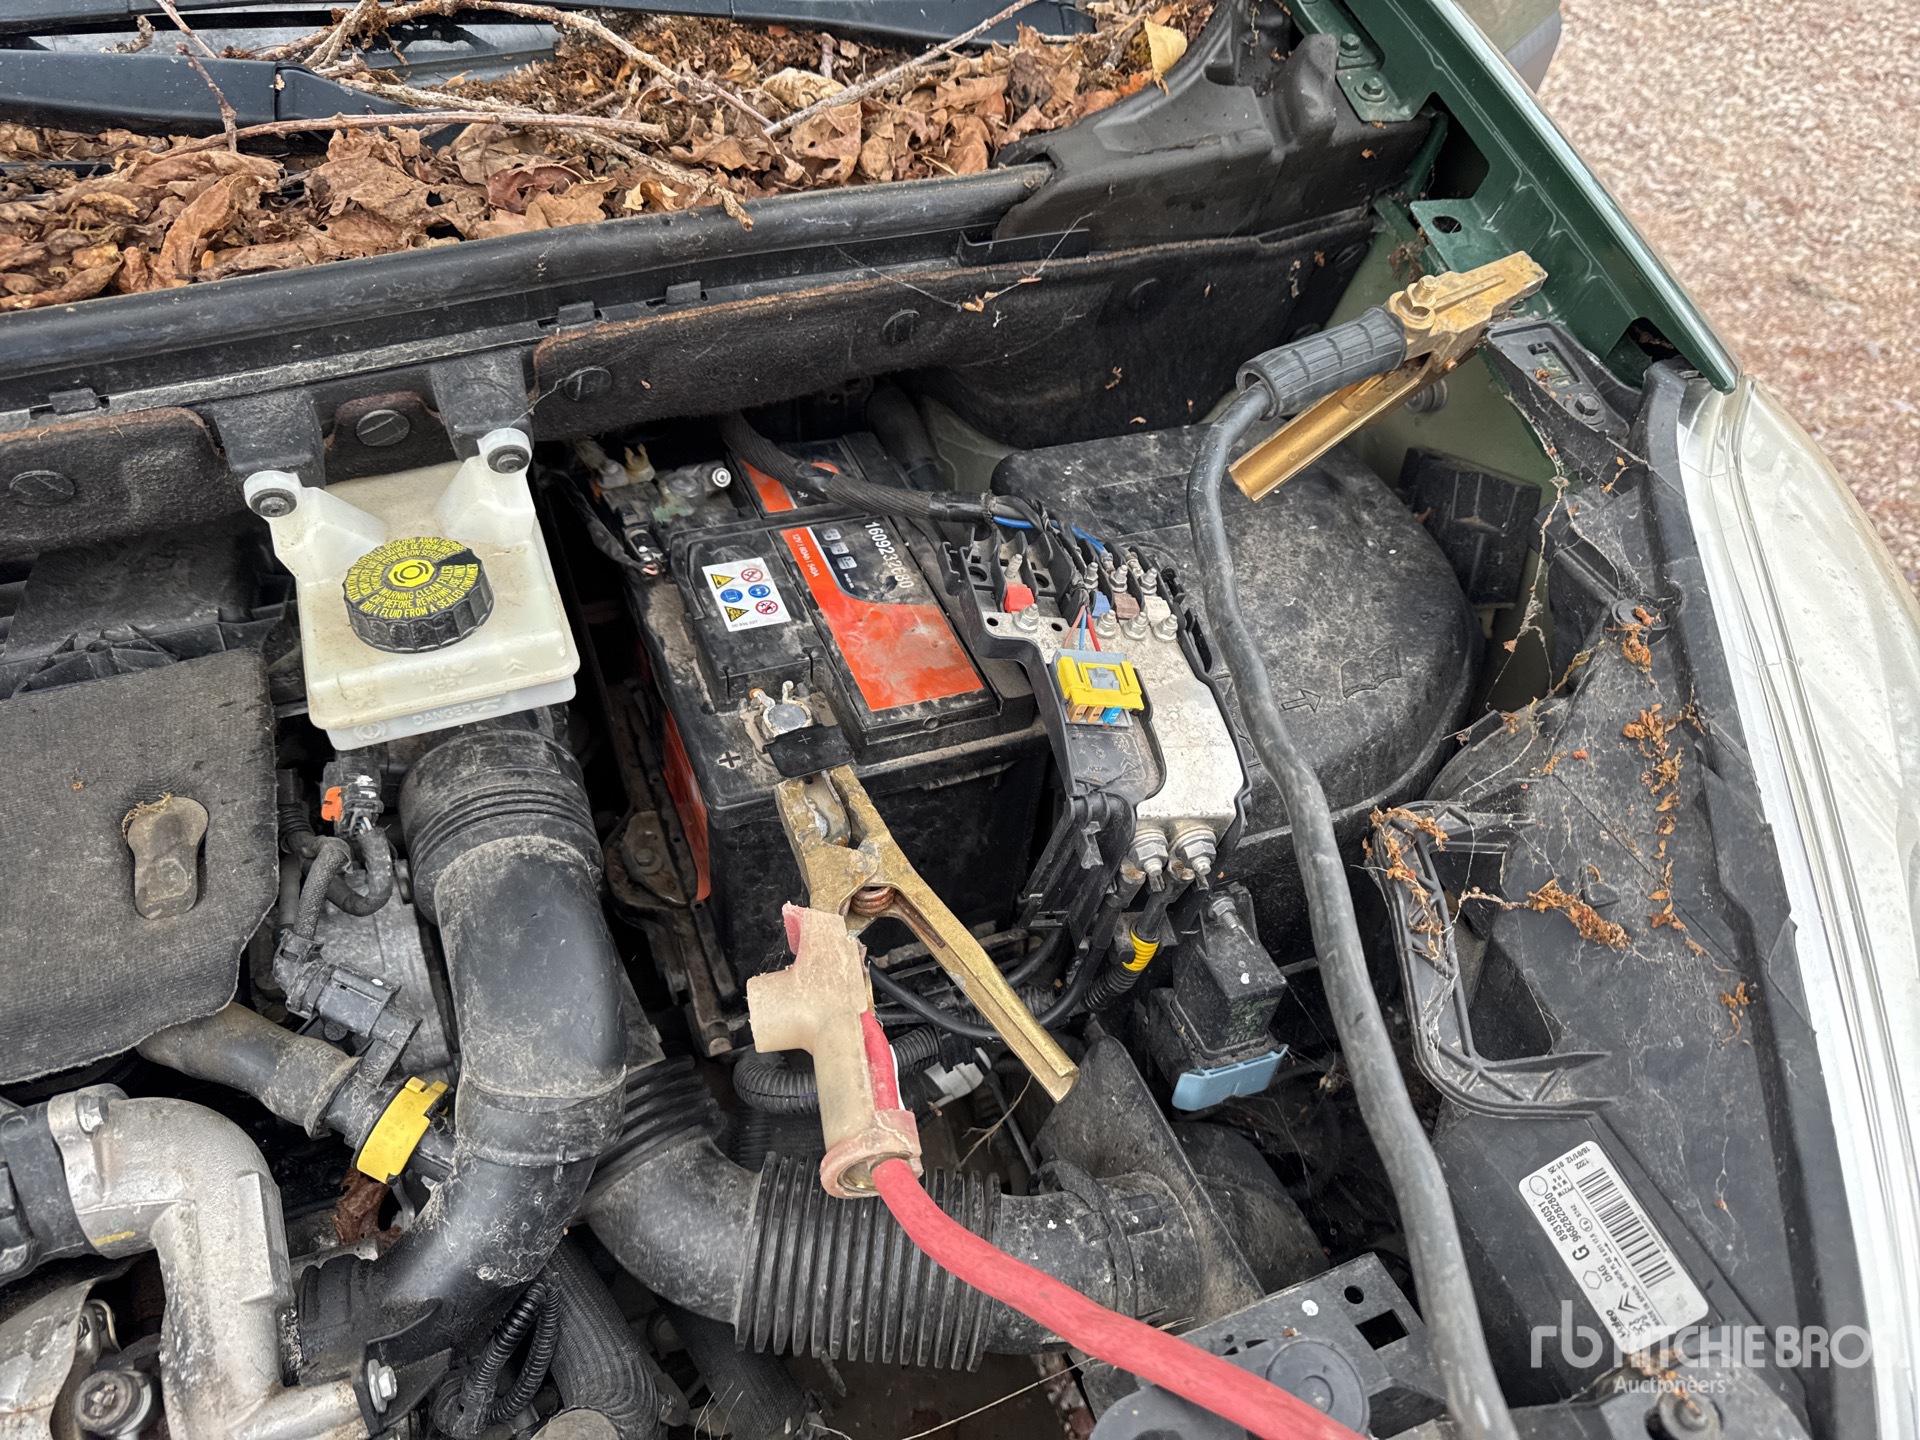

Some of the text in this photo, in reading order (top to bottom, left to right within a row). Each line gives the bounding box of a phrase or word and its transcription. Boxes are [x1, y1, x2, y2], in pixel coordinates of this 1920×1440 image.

[369, 595, 385, 605] CAP
[383, 599, 412, 608] BEFORE
[416, 587, 452, 607] REMOVING
[378, 587, 413, 600] WARNING
[416, 583, 442, 598] CLEAN
[359, 602, 374, 613] DOT
[379, 608, 402, 618] FLUID
[404, 606, 428, 617] FROM
[439, 590, 465, 608] SEALED
[412, 704, 474, 726] DANGER
[1538, 1201, 1568, 1242] 89318031
[1544, 1192, 1581, 1242] 9682828280
[1572, 1245, 1590, 1261] G
[1597, 1264, 1614, 1283] DAG
[1631, 1284, 1646, 1303] SPAIN
